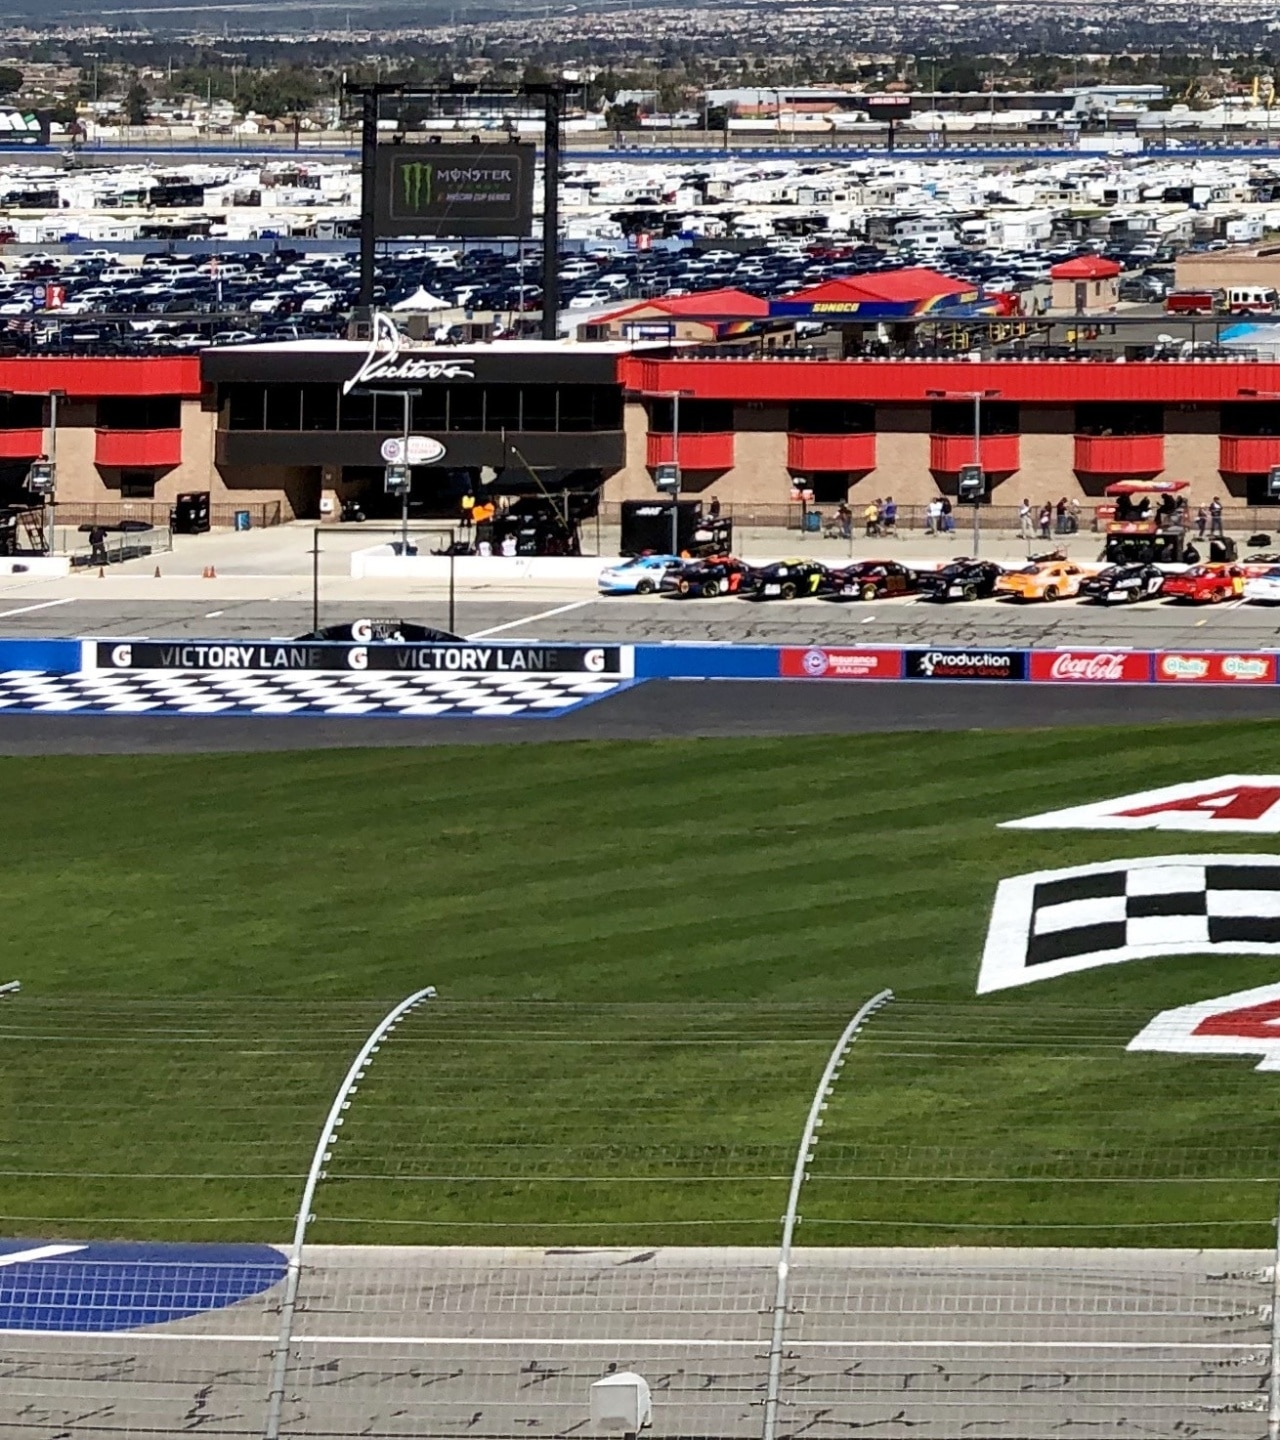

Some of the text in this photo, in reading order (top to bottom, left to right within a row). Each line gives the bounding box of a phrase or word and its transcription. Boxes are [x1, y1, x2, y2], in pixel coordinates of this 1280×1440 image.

[437, 167, 512, 182] MONSTER
[811, 303, 860, 313] SUNOCO
[159, 646, 254, 667] VICTORY
[259, 647, 322, 667] LANE
[396, 648, 490, 669] VICTORY
[497, 649, 557, 669] LANE
[932, 653, 1011, 666] Production
